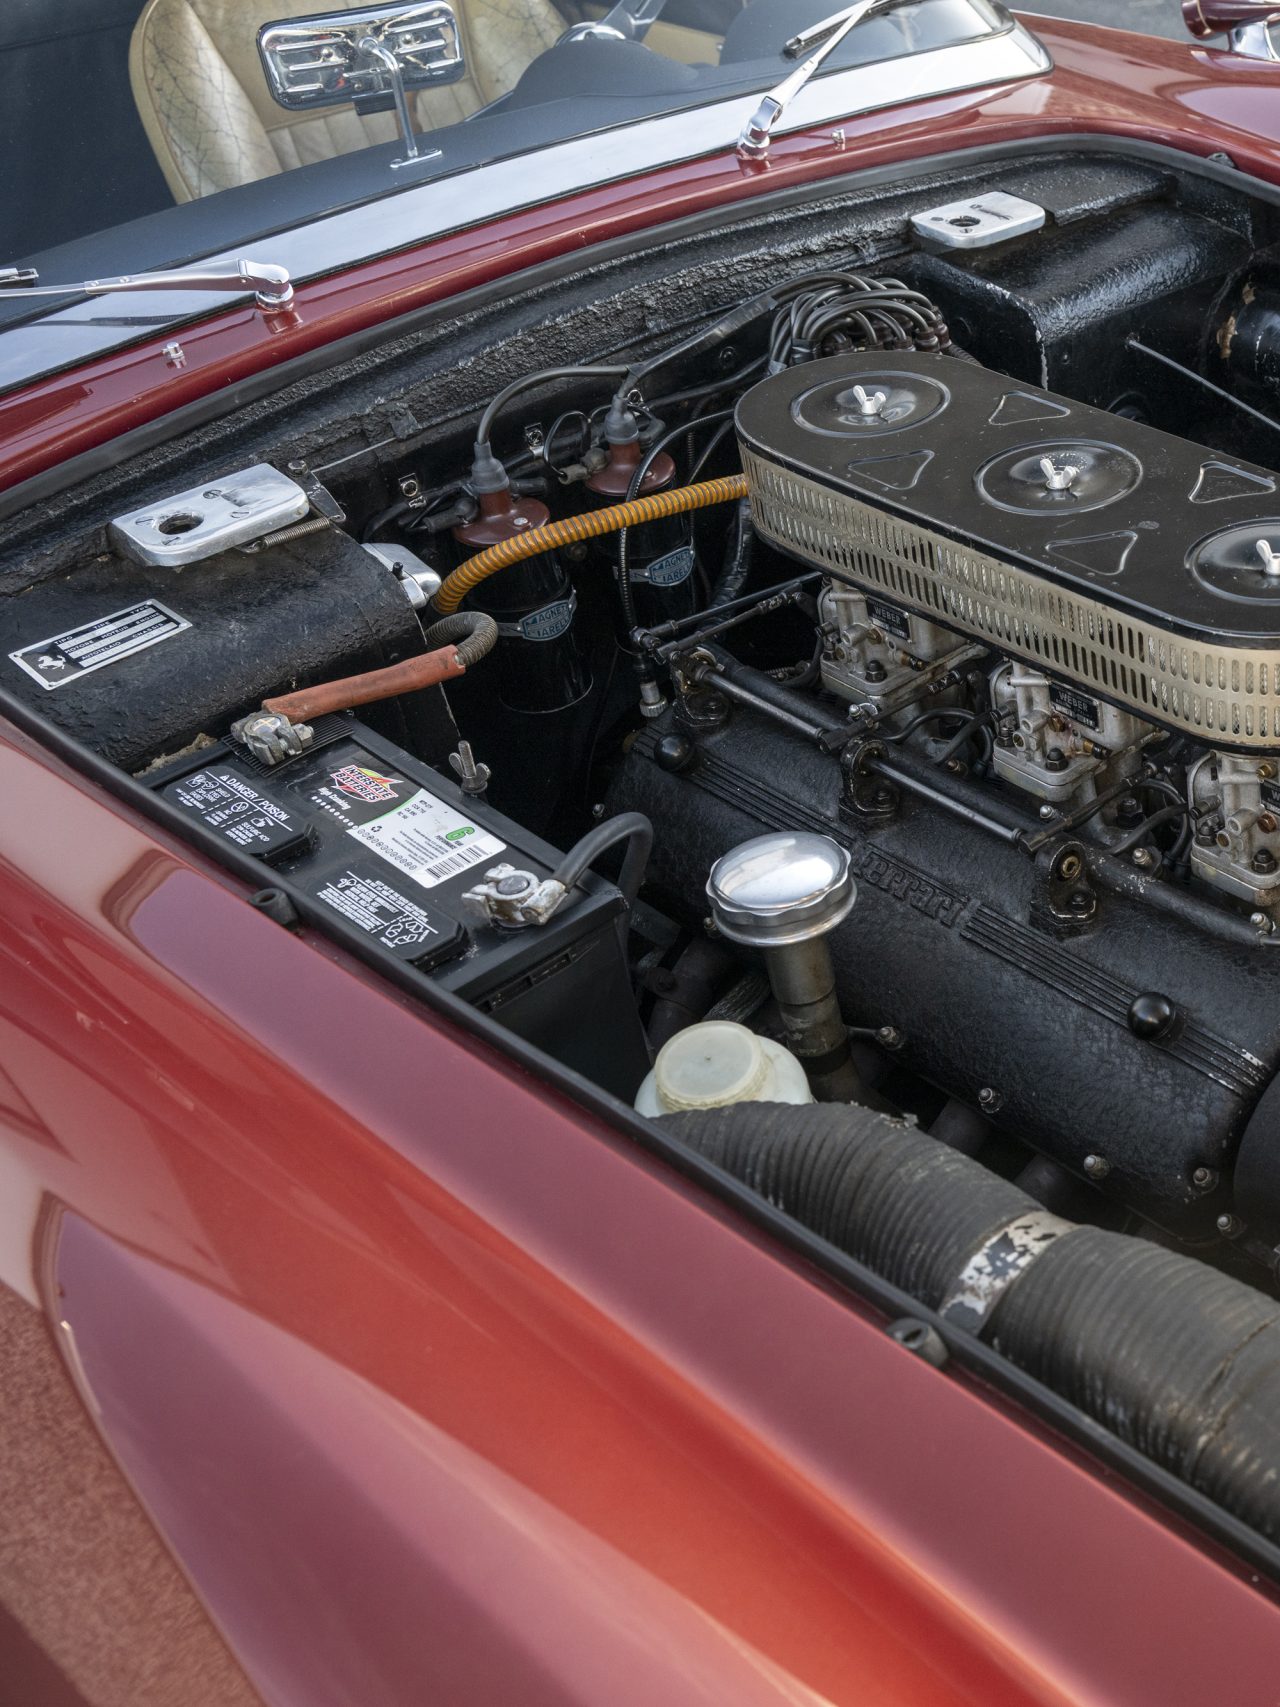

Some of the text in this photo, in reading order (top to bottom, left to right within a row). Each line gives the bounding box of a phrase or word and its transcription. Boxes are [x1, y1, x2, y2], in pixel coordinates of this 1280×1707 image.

[873, 605, 901, 625] WEBER
[54, 635, 73, 645] TIPO
[64, 639, 95, 654] MOTORE
[100, 625, 129, 639] MOTEUR
[81, 623, 164, 660] AUTOTELAIO CHASSIS
[1059, 691, 1088, 712] WEBER
[335, 772, 379, 801] BATTERIES
[345, 767, 393, 799] INTERSTATE
[227, 777, 259, 800] DANGER
[259, 799, 290, 822] POISON
[445, 826, 476, 841] 6
